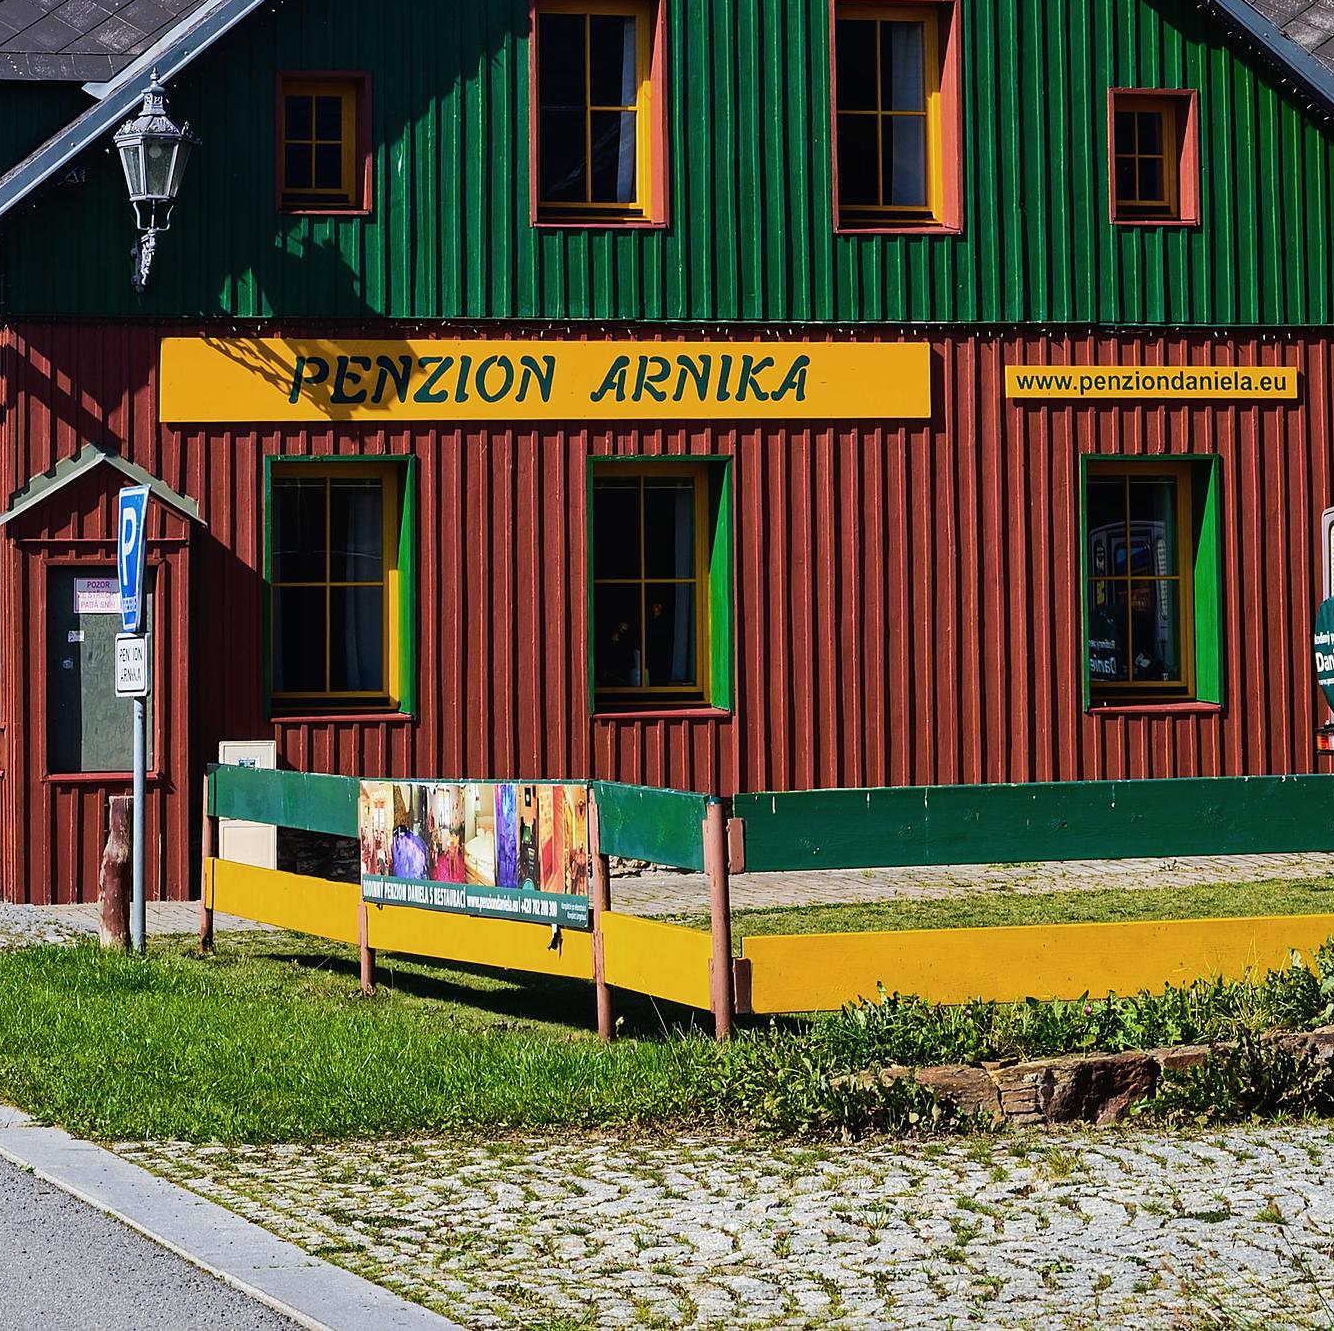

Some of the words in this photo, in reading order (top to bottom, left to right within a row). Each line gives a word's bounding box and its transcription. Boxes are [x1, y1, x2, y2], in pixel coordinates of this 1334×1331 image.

[289, 355, 557, 405] PENZION
[590, 355, 810, 403] ARNIKA
[1016, 371, 1287, 395] www.penziondaniela.eu
[121, 507, 137, 586] P
[87, 581, 110, 589] POZOR
[119, 648, 143, 662] PENION
